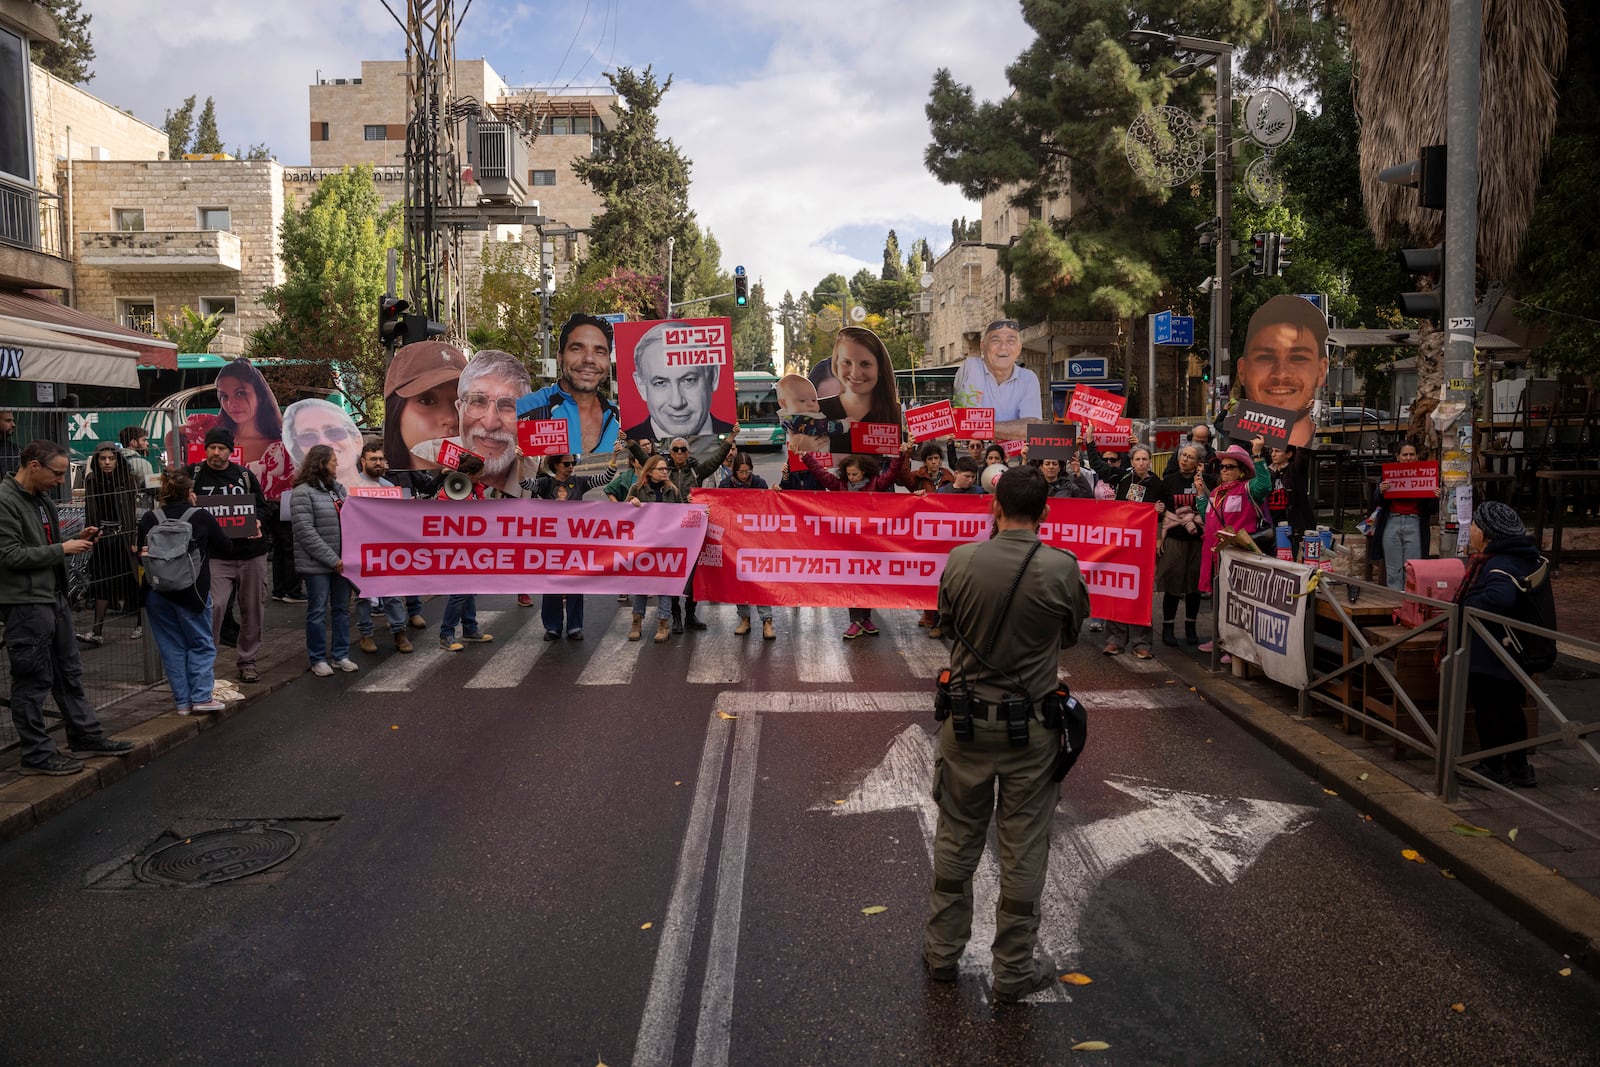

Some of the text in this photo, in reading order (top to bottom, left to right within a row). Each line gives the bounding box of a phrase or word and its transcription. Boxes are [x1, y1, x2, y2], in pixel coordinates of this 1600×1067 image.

[284, 170, 319, 182] bank
[666, 328, 721, 346] קבינט
[667, 349, 722, 366] המוות
[967, 410, 992, 419] עדיין
[1244, 410, 1286, 429] מחלות
[537, 422, 565, 433] עדיין
[870, 425, 897, 434] עדיין
[961, 421, 992, 430] בעזה.
[1237, 419, 1287, 439] מדבקות
[531, 435, 566, 444] בעזה.
[865, 436, 898, 445] בעזה.
[1030, 437, 1073, 447] אובדנות
[1419, 468, 1437, 477] קול
[1411, 480, 1433, 489] זועק
[233, 505, 254, 515] תת
[422, 515, 635, 540] END THE WAR
[736, 514, 797, 532] בשבי
[803, 515, 862, 536] חורף
[868, 516, 910, 535] עוד
[917, 519, 986, 538] ישרדו
[1039, 522, 1142, 548] החטופים
[366, 548, 515, 572] HOSTAGE
[523, 549, 604, 572] DEAL
[612, 550, 684, 573] NOW
[741, 555, 841, 575] המלחמה
[848, 559, 882, 575] את
[889, 560, 936, 577] סיים
[1271, 574, 1295, 605] פדיון
[1257, 611, 1287, 648] ניצחון
